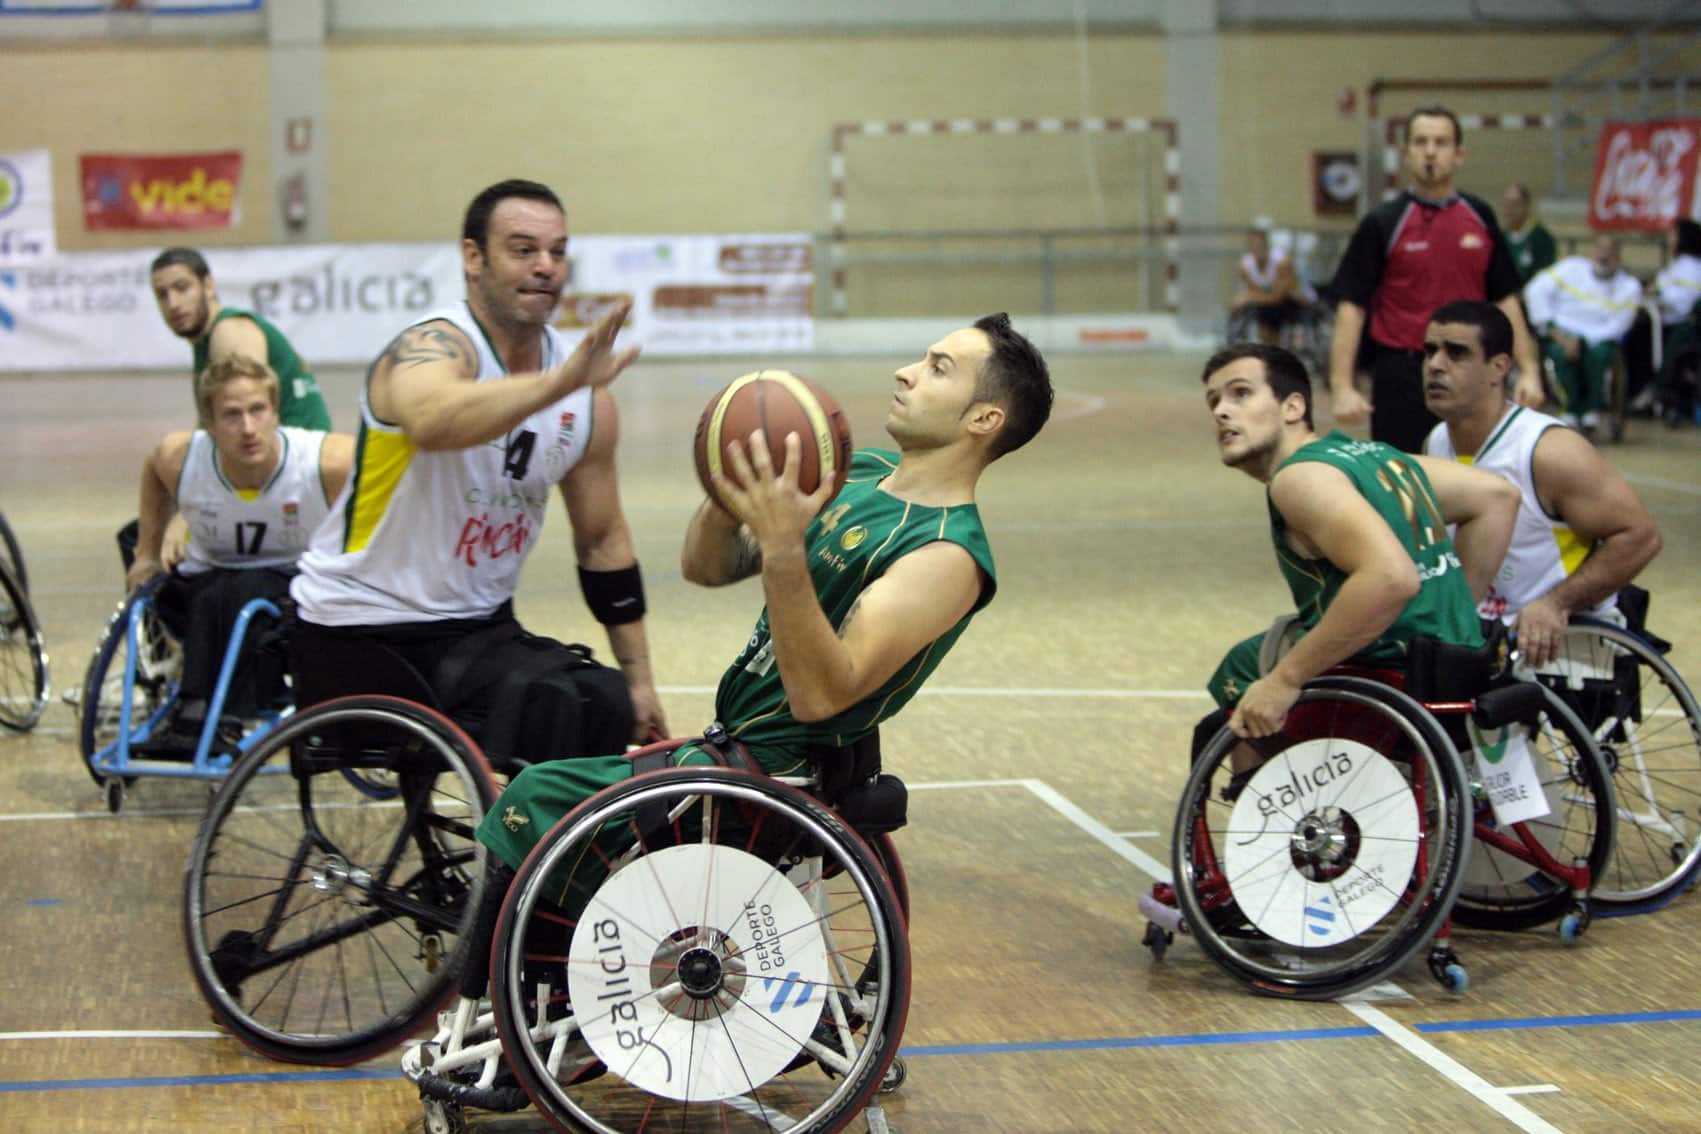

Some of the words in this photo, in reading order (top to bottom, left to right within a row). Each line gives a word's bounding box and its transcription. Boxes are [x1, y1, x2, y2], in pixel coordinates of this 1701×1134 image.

[250, 266, 434, 318] galicia
[235, 521, 268, 555] 17
[1237, 751, 1354, 846] galicia
[744, 899, 771, 972] DEPORTE
[761, 904, 785, 968] GALEGO
[594, 918, 673, 1084] galicia
